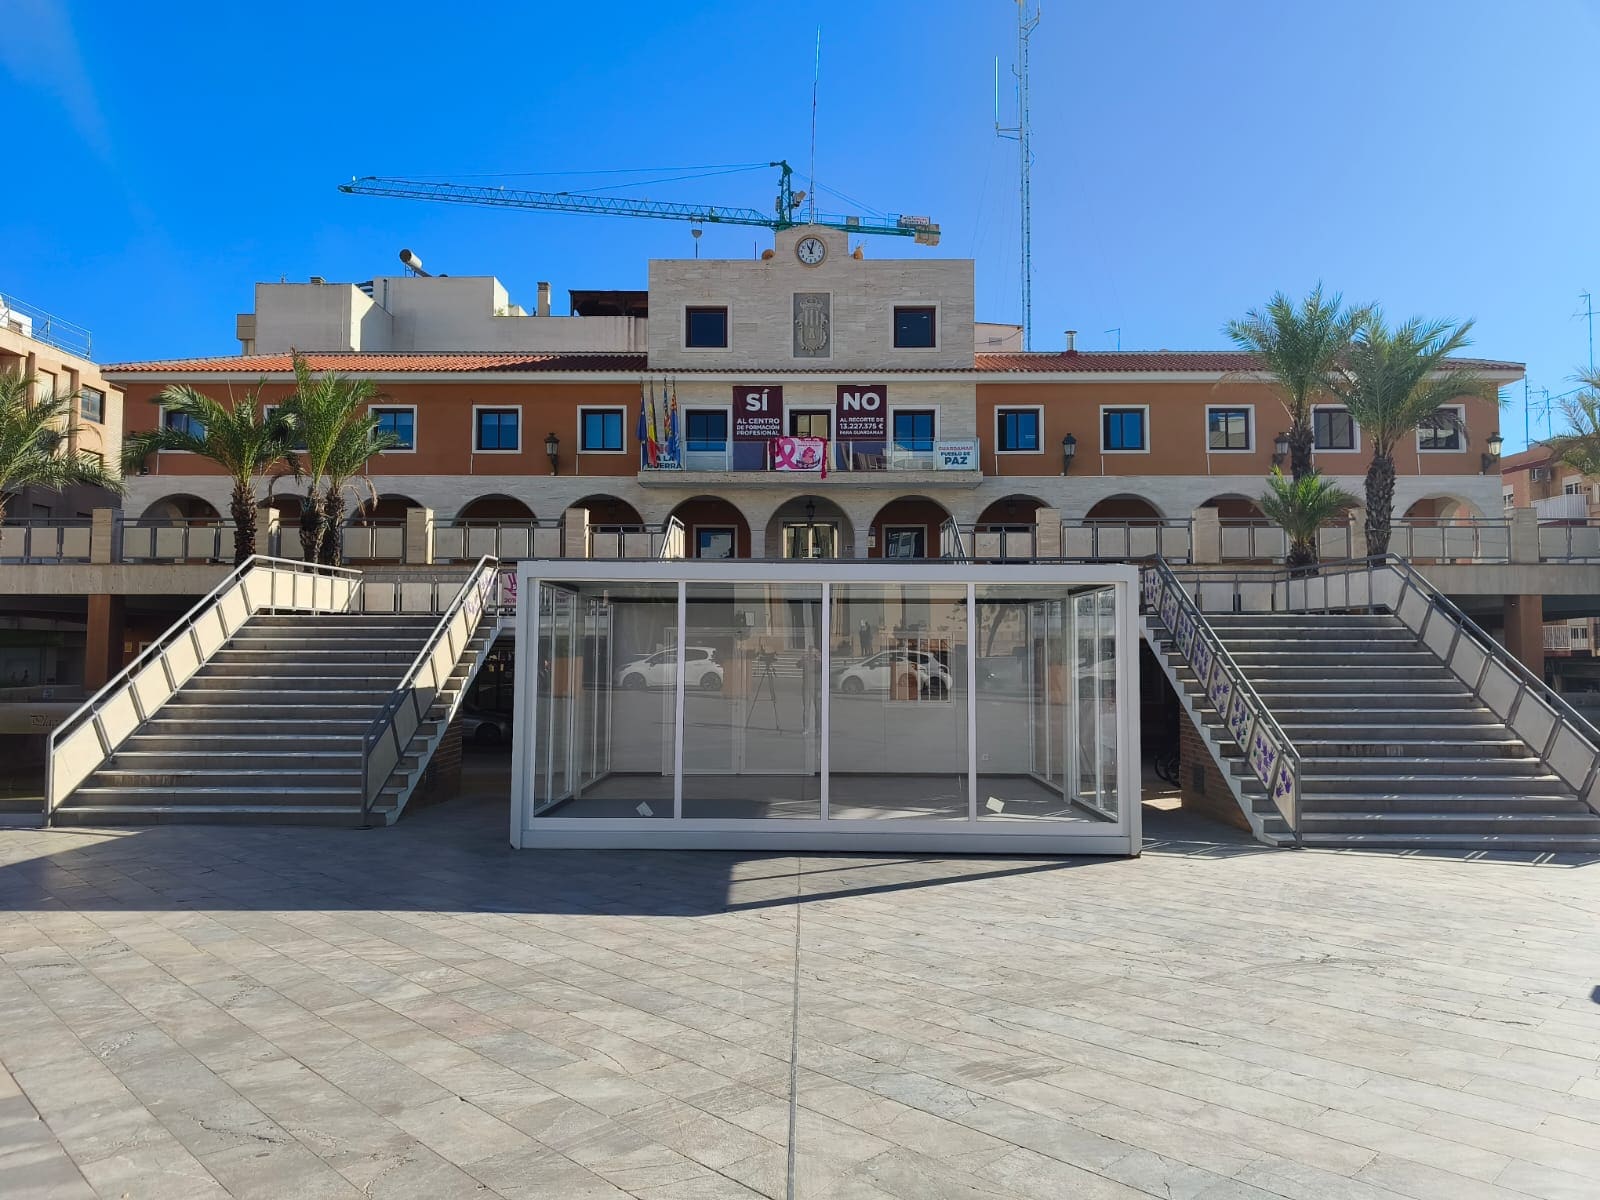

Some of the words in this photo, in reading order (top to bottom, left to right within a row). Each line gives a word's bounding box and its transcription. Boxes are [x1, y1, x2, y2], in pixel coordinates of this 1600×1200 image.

[746, 389, 770, 411] SÍ
[843, 392, 880, 411] NO
[945, 456, 967, 464] PAZ
